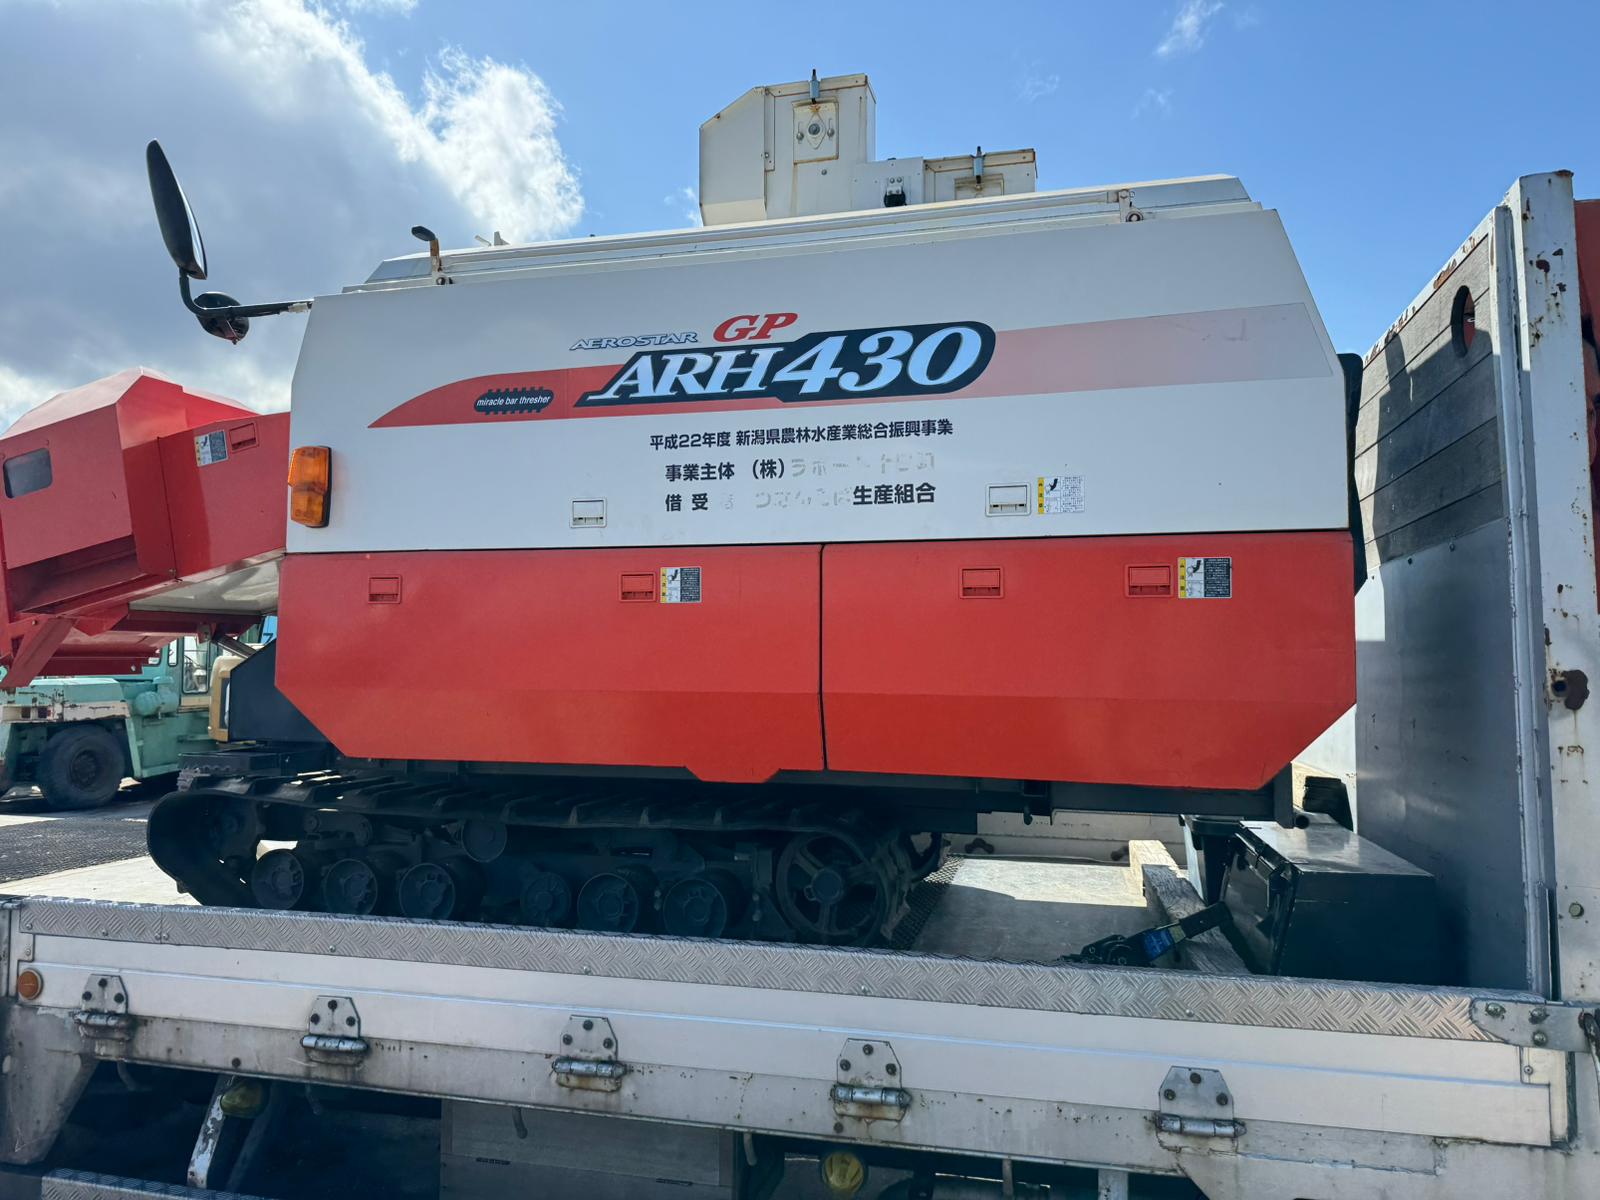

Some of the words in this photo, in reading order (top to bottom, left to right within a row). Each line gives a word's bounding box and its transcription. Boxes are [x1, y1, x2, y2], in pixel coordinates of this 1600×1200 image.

[569, 331, 699, 351] AEROSTAR
[713, 312, 799, 343] GP
[586, 326, 982, 401] ARH430
[476, 397, 504, 407] miracle
[505, 396, 519, 406] bar
[519, 395, 551, 405] thresher
[650, 431, 731, 451] 平成22年度
[736, 418, 954, 447] 新潟県農林水産業総合振興事業
[665, 462, 735, 482] 事業主体
[853, 482, 936, 505] 生産組合
